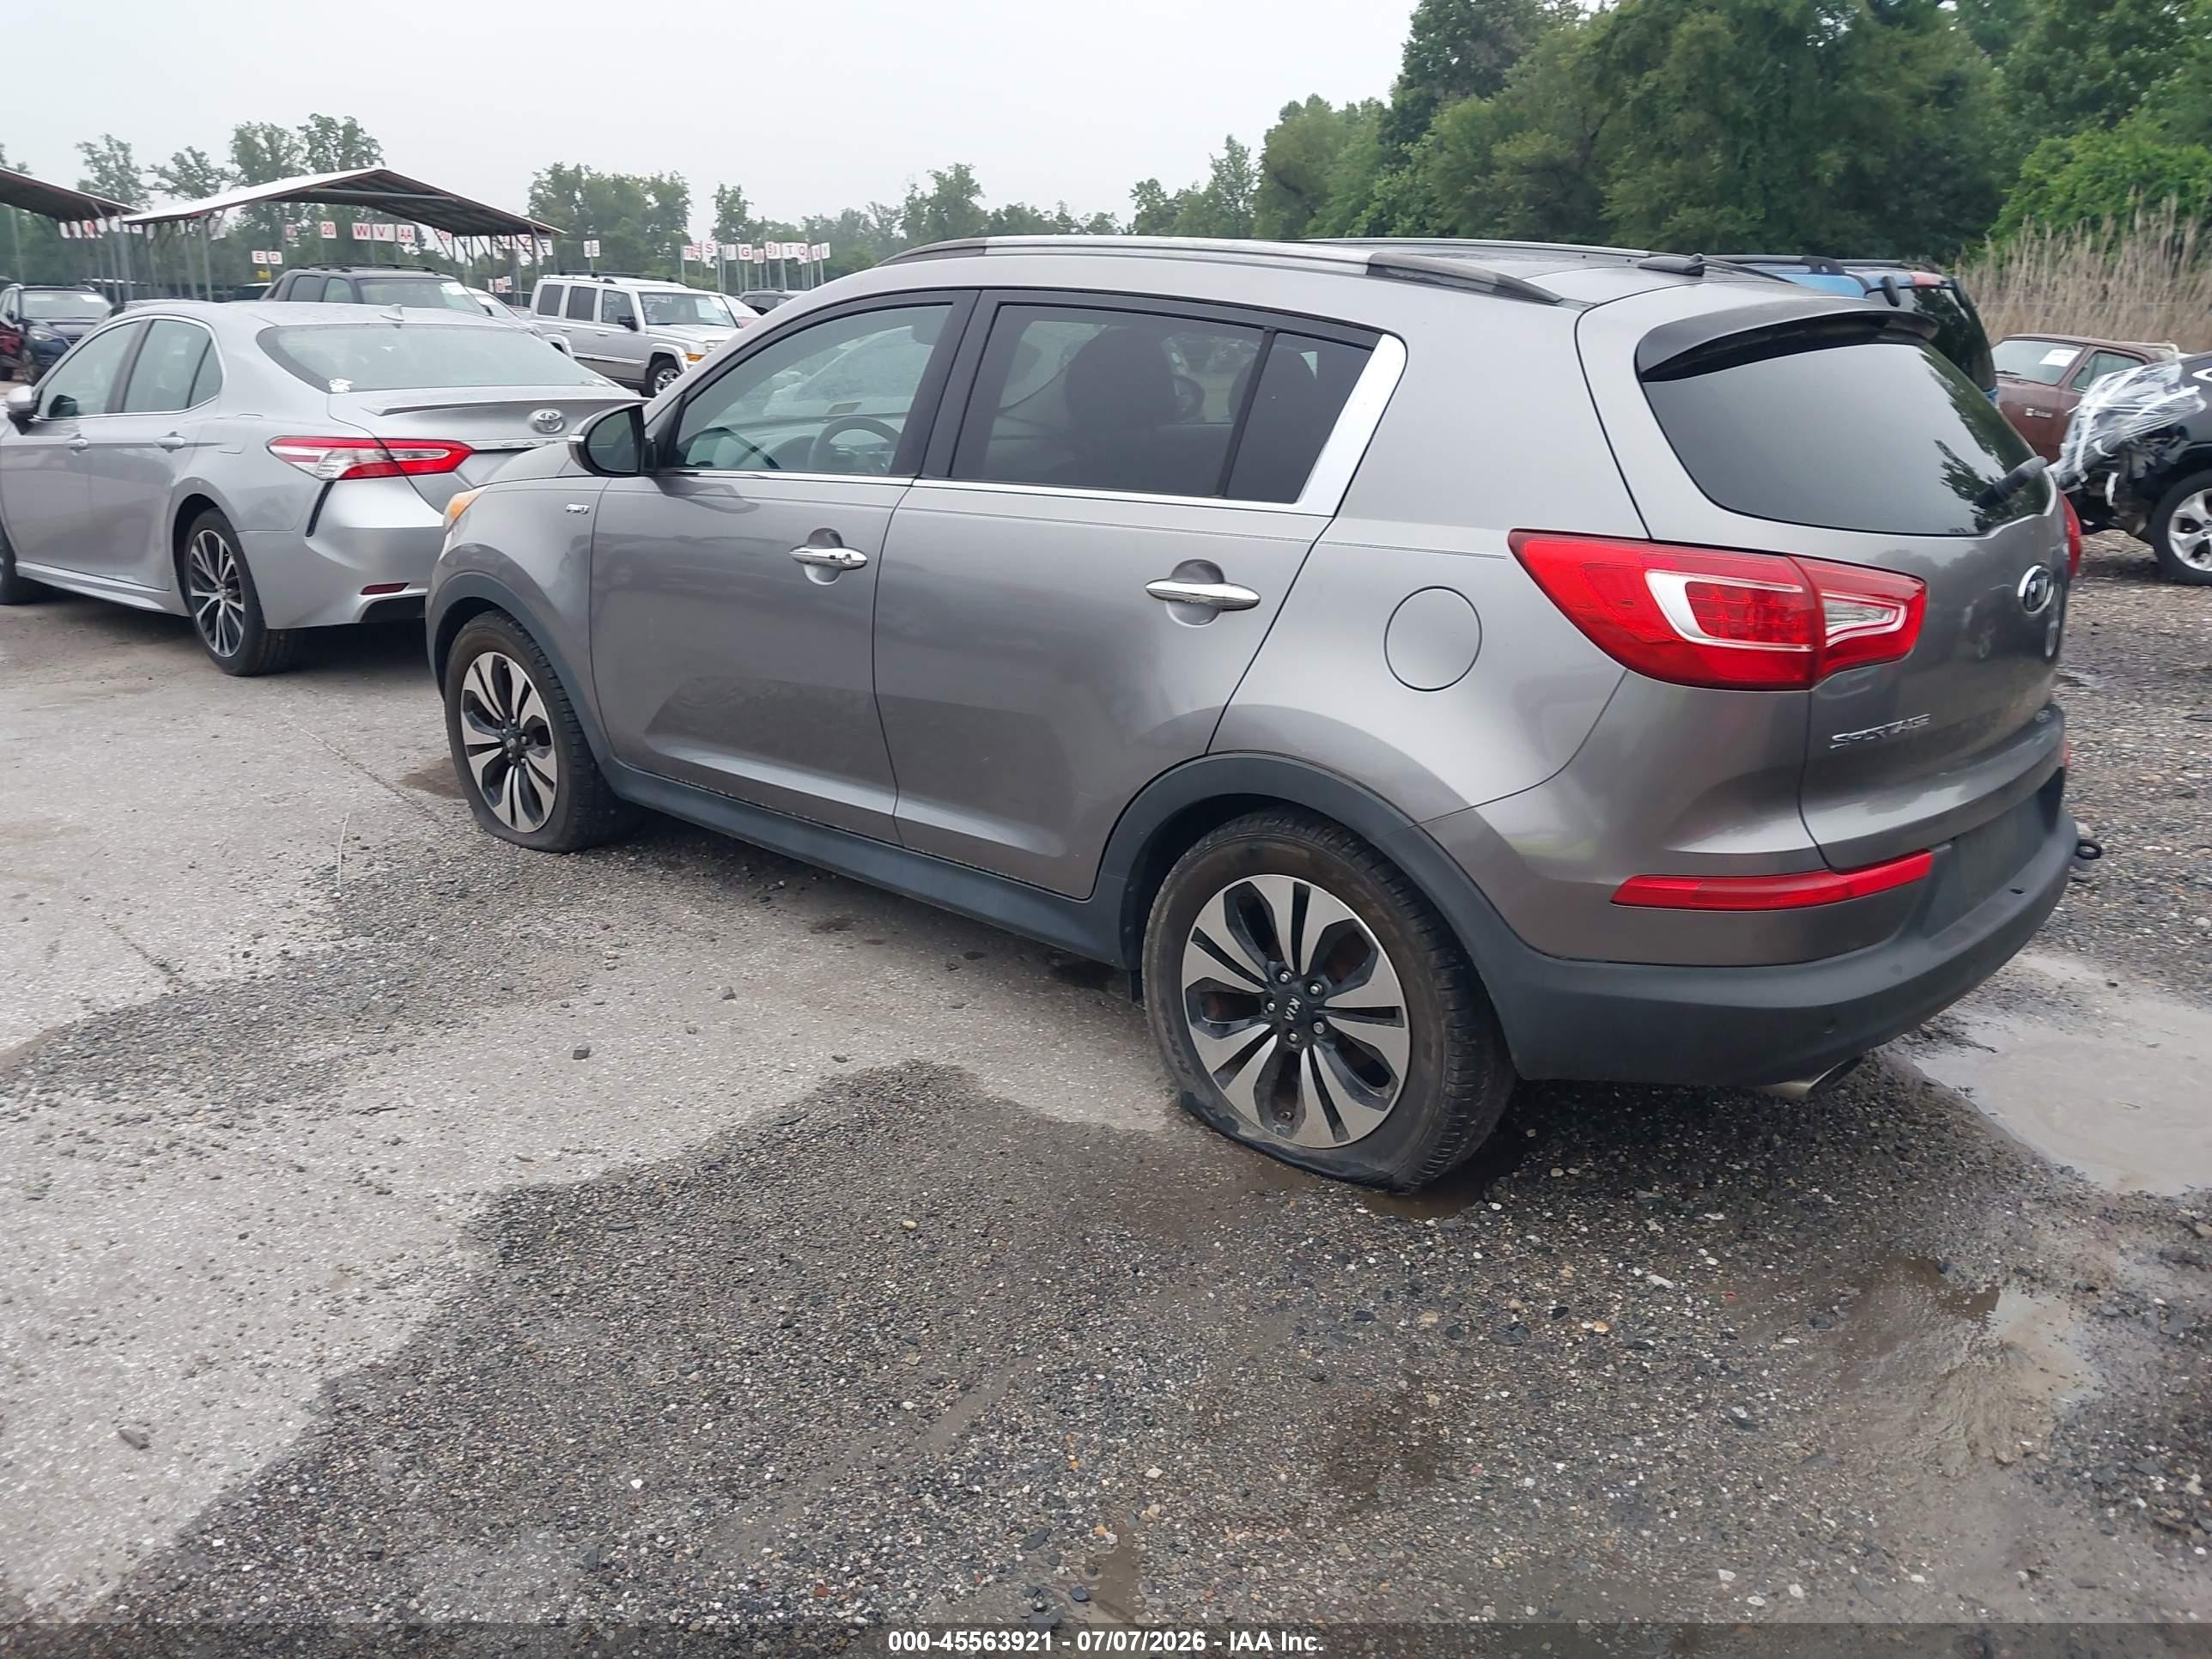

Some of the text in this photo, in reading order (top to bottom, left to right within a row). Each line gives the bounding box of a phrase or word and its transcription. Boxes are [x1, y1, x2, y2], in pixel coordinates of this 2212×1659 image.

[356, 225, 368, 237] W
[376, 226, 386, 237] V
[741, 246, 750, 257] G
[1285, 997, 1301, 1021] KIA
